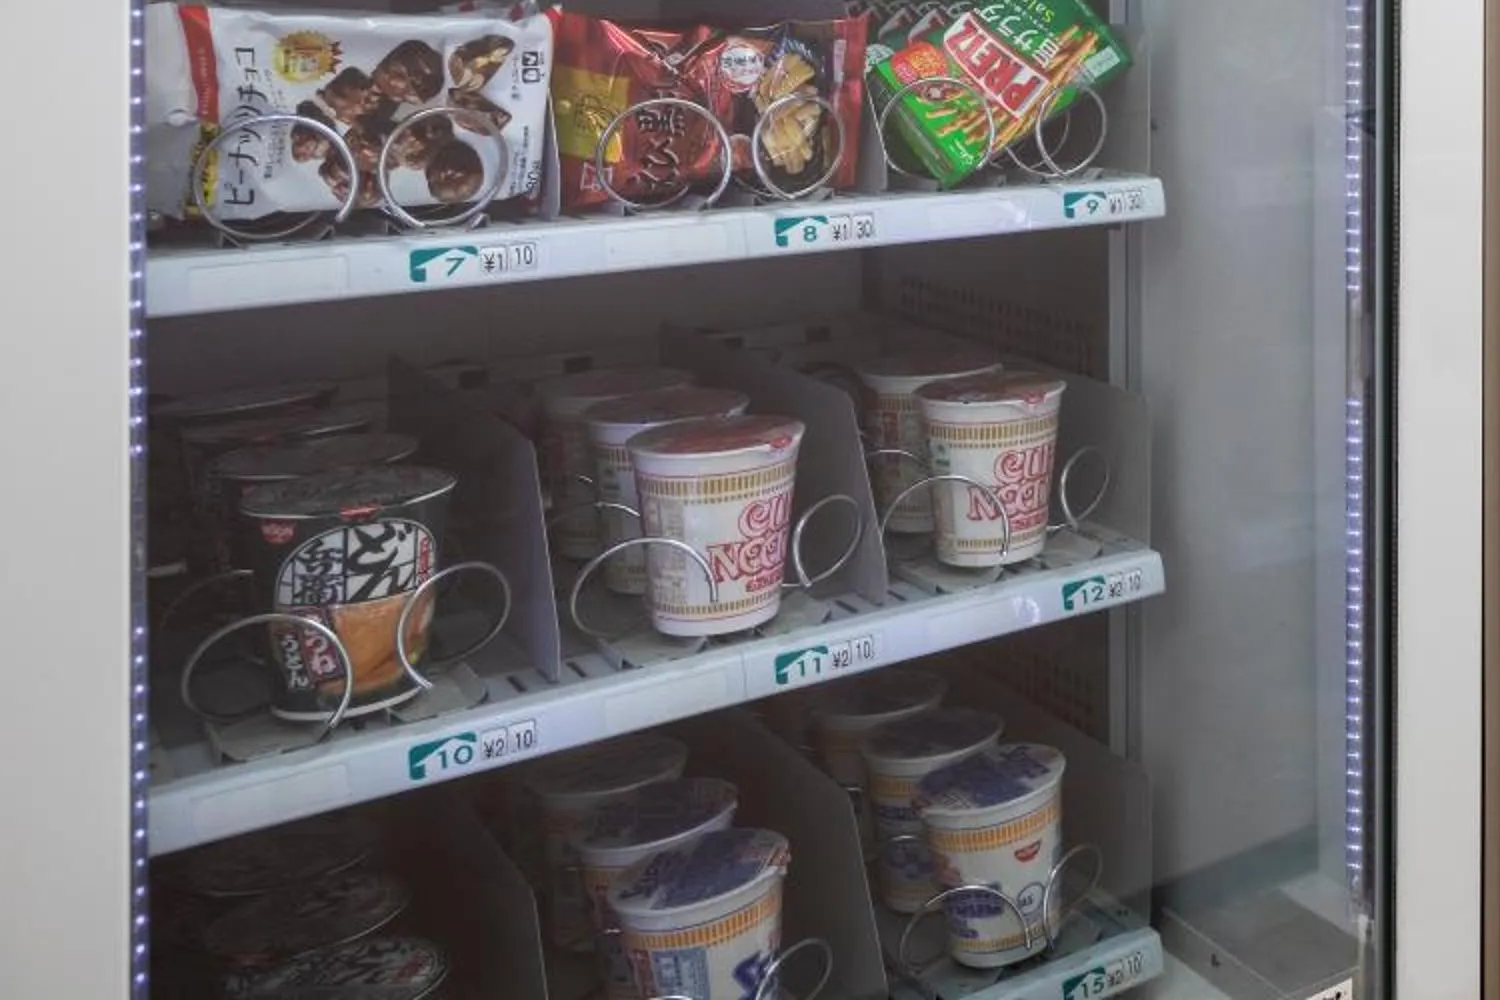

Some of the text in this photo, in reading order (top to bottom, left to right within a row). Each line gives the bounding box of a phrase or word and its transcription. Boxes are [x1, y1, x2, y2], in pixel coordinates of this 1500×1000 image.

[947, 22, 1042, 112] PRETZ
[1086, 200, 1099, 216] 9
[803, 225, 818, 243] 8
[446, 257, 466, 277] 7
[1081, 583, 1106, 606] 12
[796, 657, 822, 677] 11
[438, 744, 475, 771] 10
[1080, 976, 1105, 998] 15
